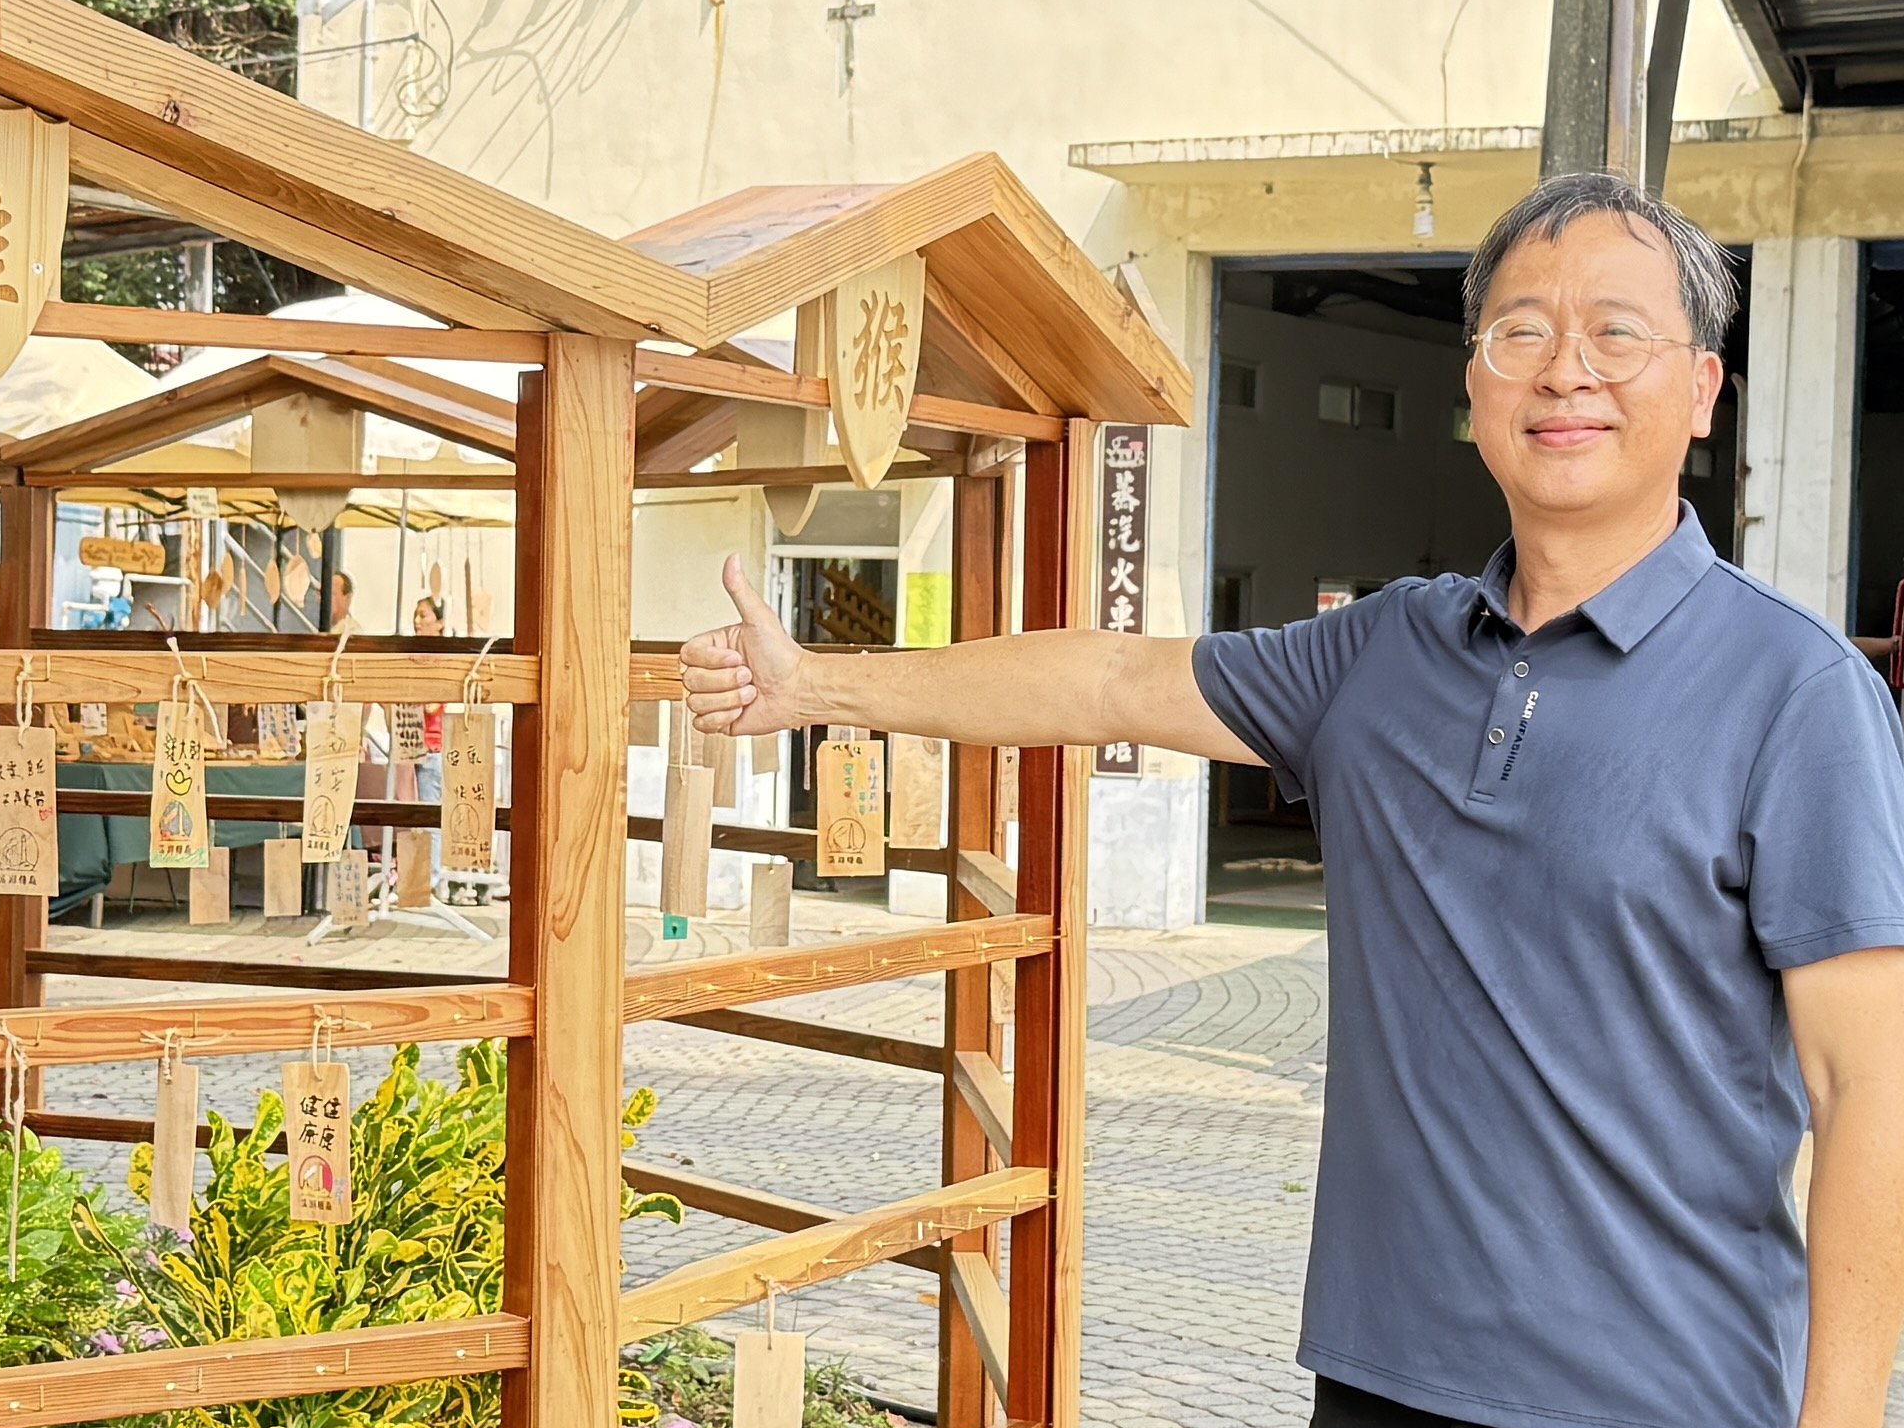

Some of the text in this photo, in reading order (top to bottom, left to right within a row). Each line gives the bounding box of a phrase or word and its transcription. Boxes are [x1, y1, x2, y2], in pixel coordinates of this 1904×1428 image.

[853, 289, 909, 415] 猴
[1103, 470, 1141, 763] 蒸汽火車館
